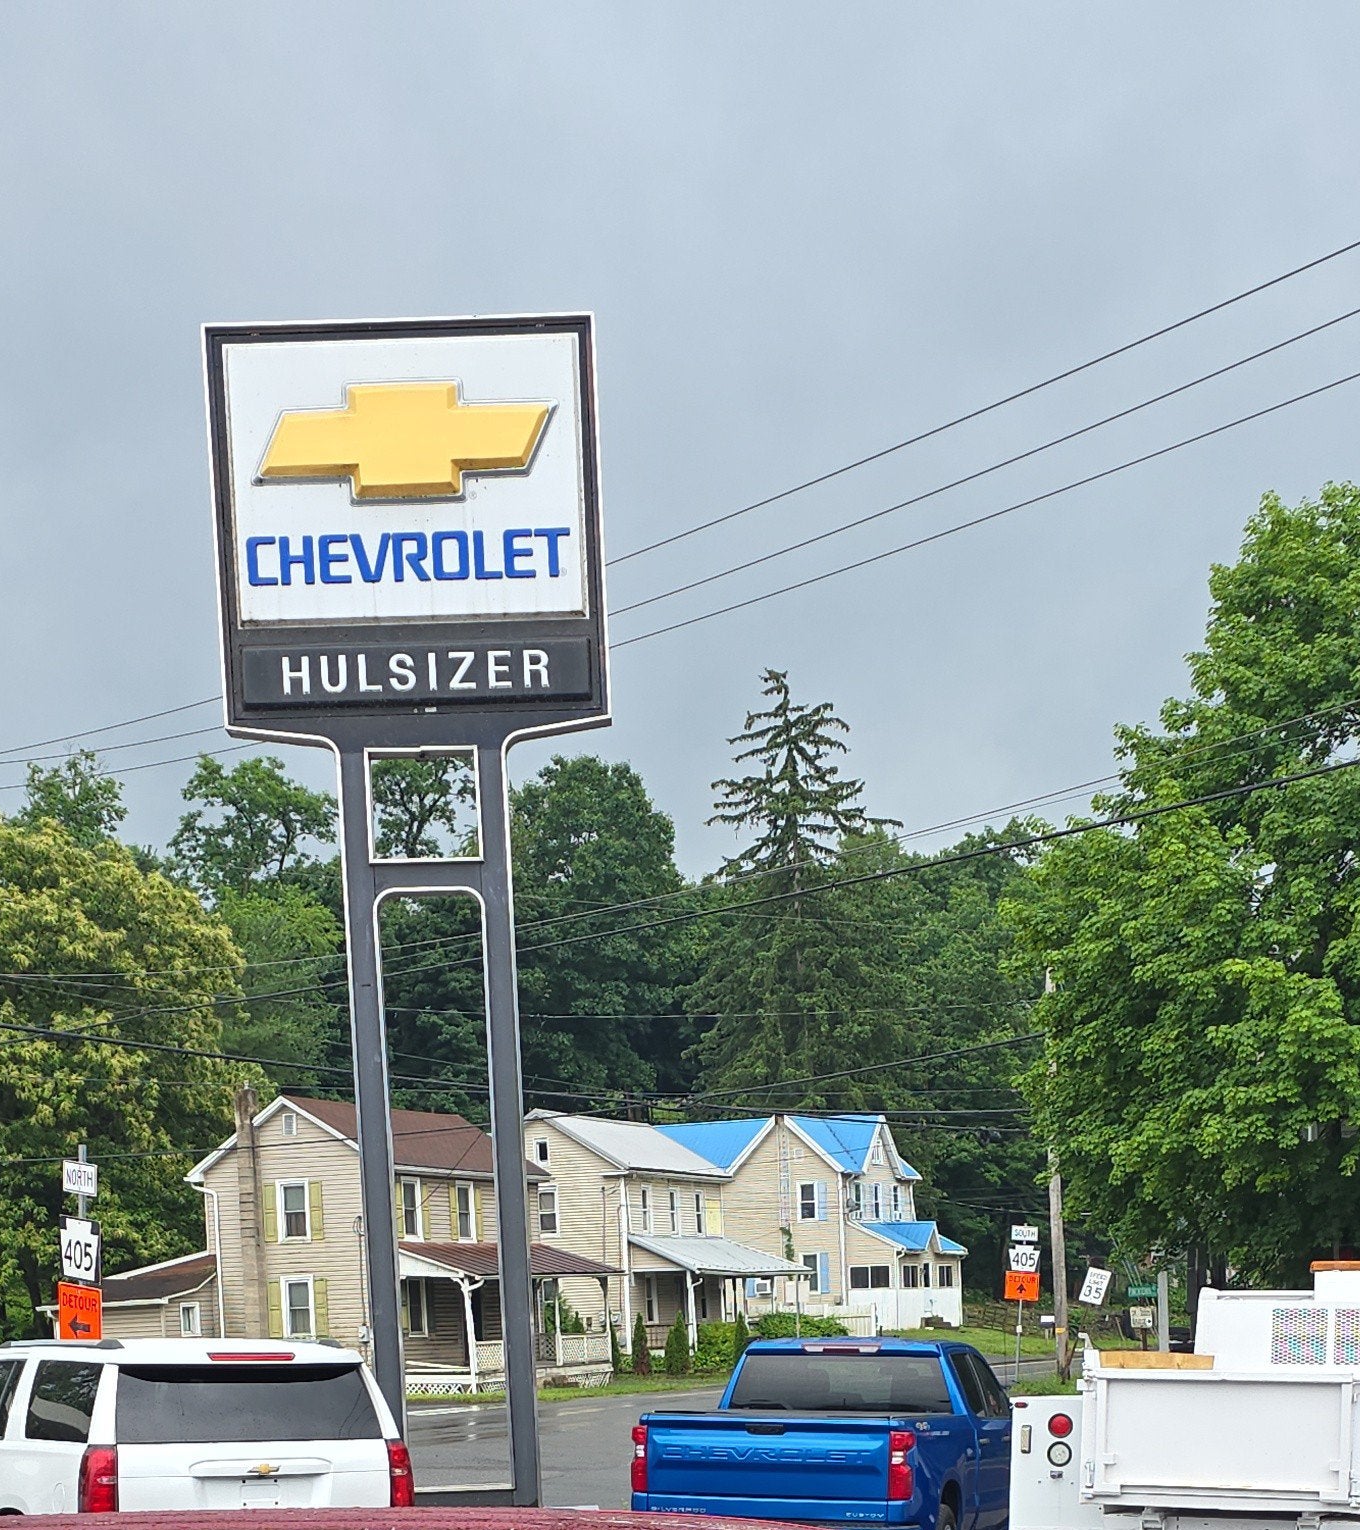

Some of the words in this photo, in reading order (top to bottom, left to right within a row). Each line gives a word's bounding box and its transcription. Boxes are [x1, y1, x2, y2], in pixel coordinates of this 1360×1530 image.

[246, 527, 570, 586] CHEVROLET
[281, 649, 551, 695] HULSIZER
[66, 1167, 94, 1188] NORTH
[1014, 1228, 1036, 1238] SOUTH
[63, 1240, 94, 1272] 405
[1012, 1252, 1036, 1267] 405
[1008, 1275, 1037, 1284] DETOUR
[1083, 1285, 1103, 1299] 35
[62, 1293, 98, 1313] DETOUR
[662, 1445, 872, 1464] CHEVROLET
